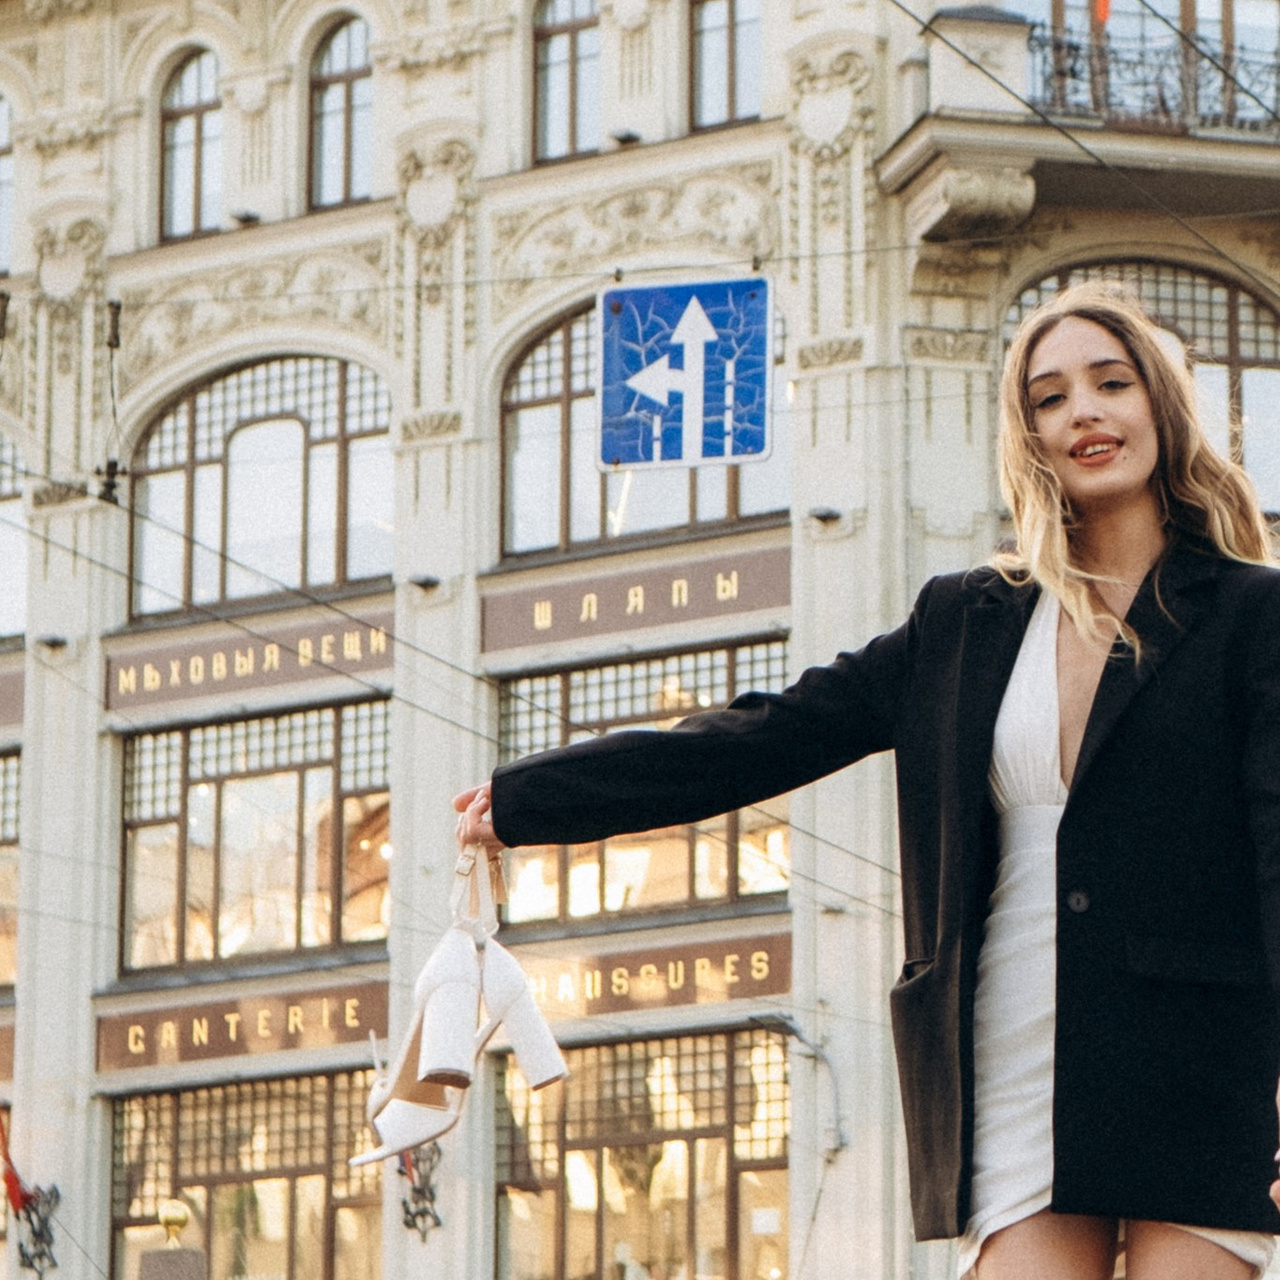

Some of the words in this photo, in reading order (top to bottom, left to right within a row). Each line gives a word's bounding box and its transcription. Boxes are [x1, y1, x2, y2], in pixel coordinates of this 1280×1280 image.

[533, 569, 739, 631] ШЛЯПЫ
[298, 626, 387, 668] ВЕЩИ
[525, 950, 770, 1004] HAUSSURES
